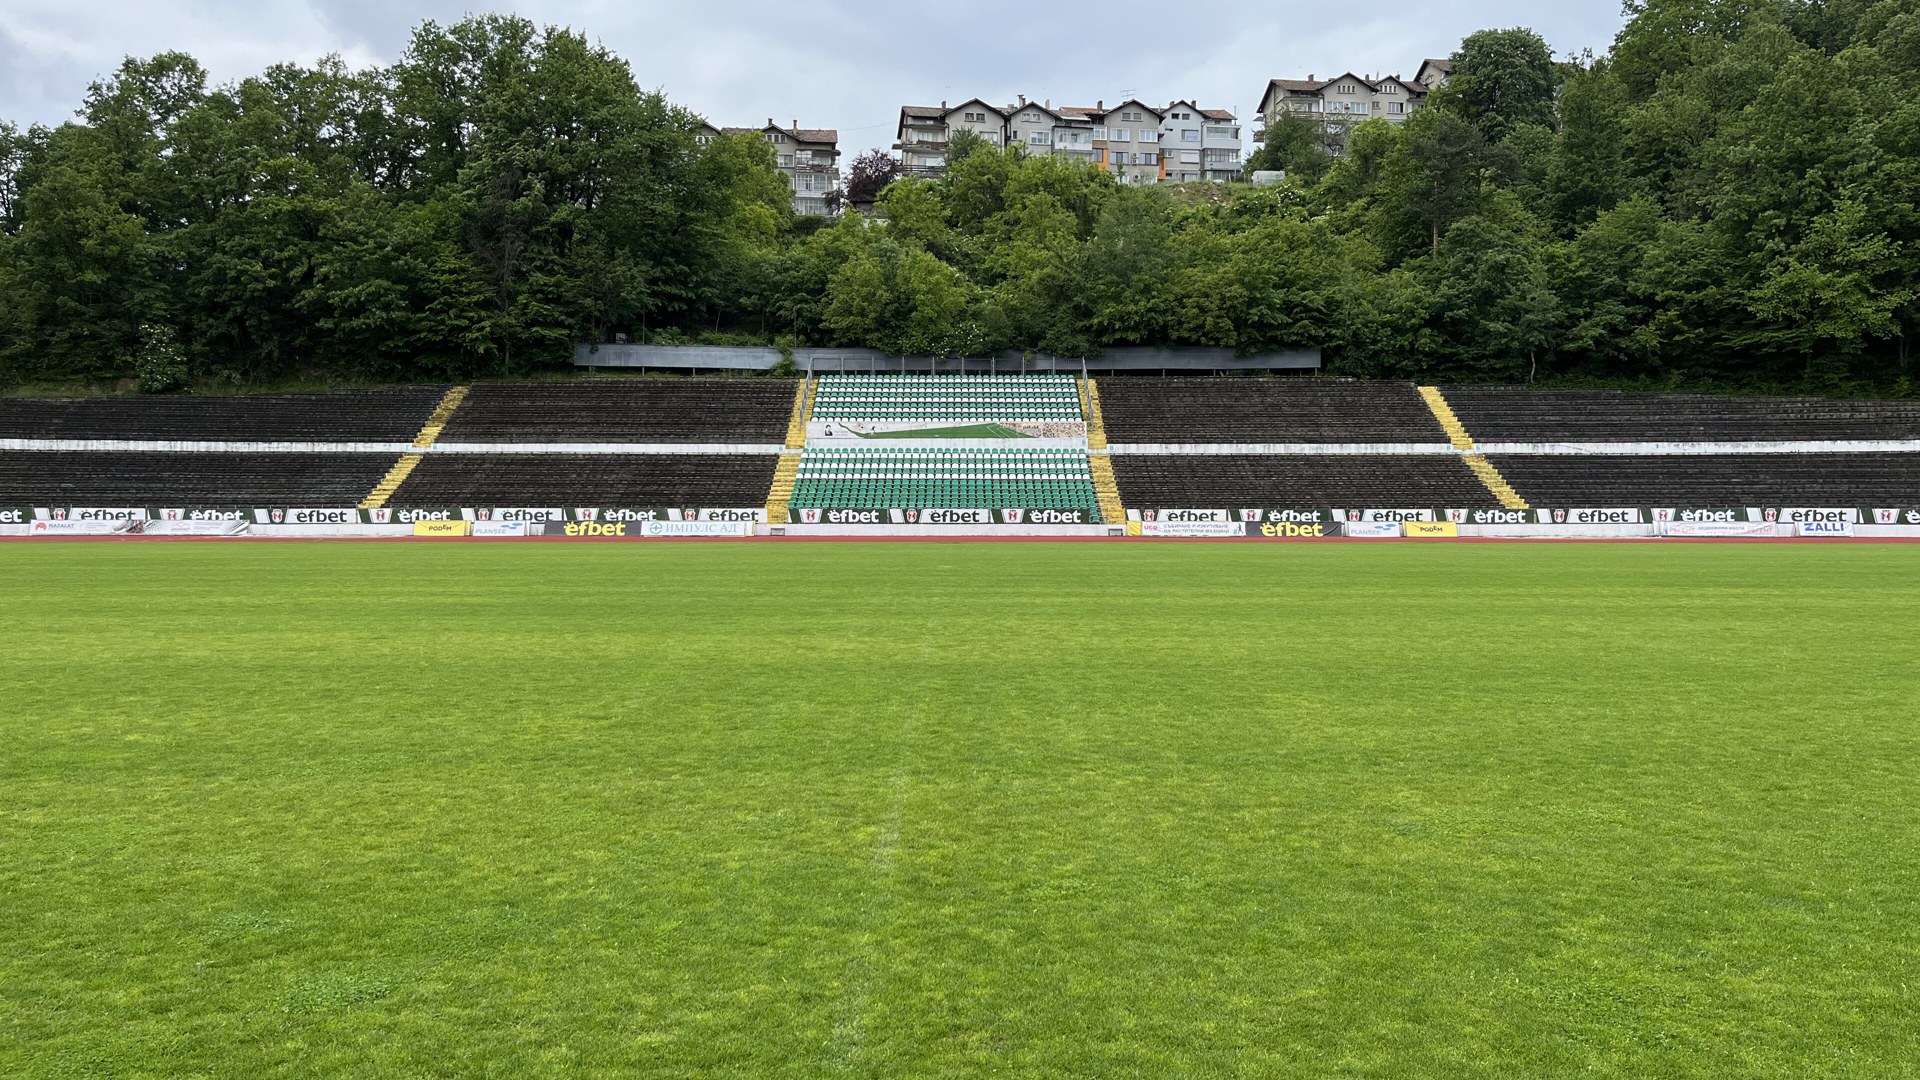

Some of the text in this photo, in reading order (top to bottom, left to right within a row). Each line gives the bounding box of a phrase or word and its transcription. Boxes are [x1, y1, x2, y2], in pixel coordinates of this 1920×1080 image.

[80, 510, 136, 520] efbet
[190, 510, 243, 520] efbet
[296, 510, 347, 522] efbet
[398, 510, 450, 522] efbet
[502, 510, 553, 521] efbet
[604, 510, 656, 521] efbet
[709, 510, 758, 521] efbet
[828, 510, 879, 522] efbet
[930, 510, 979, 522] efbet
[1030, 510, 1081, 523] efbet
[1168, 511, 1217, 521] efbet
[1268, 510, 1320, 521] efbet
[1373, 511, 1422, 521] efbet
[1474, 510, 1526, 523] efbet
[1578, 510, 1628, 522] efbet
[1681, 510, 1735, 521] efbet
[1790, 510, 1846, 521] efbet
[564, 522, 626, 536] efbet
[665, 524, 716, 532] ИМПУЛС
[1260, 522, 1323, 536] efbet
[1804, 523, 1844, 531] ZALLI
